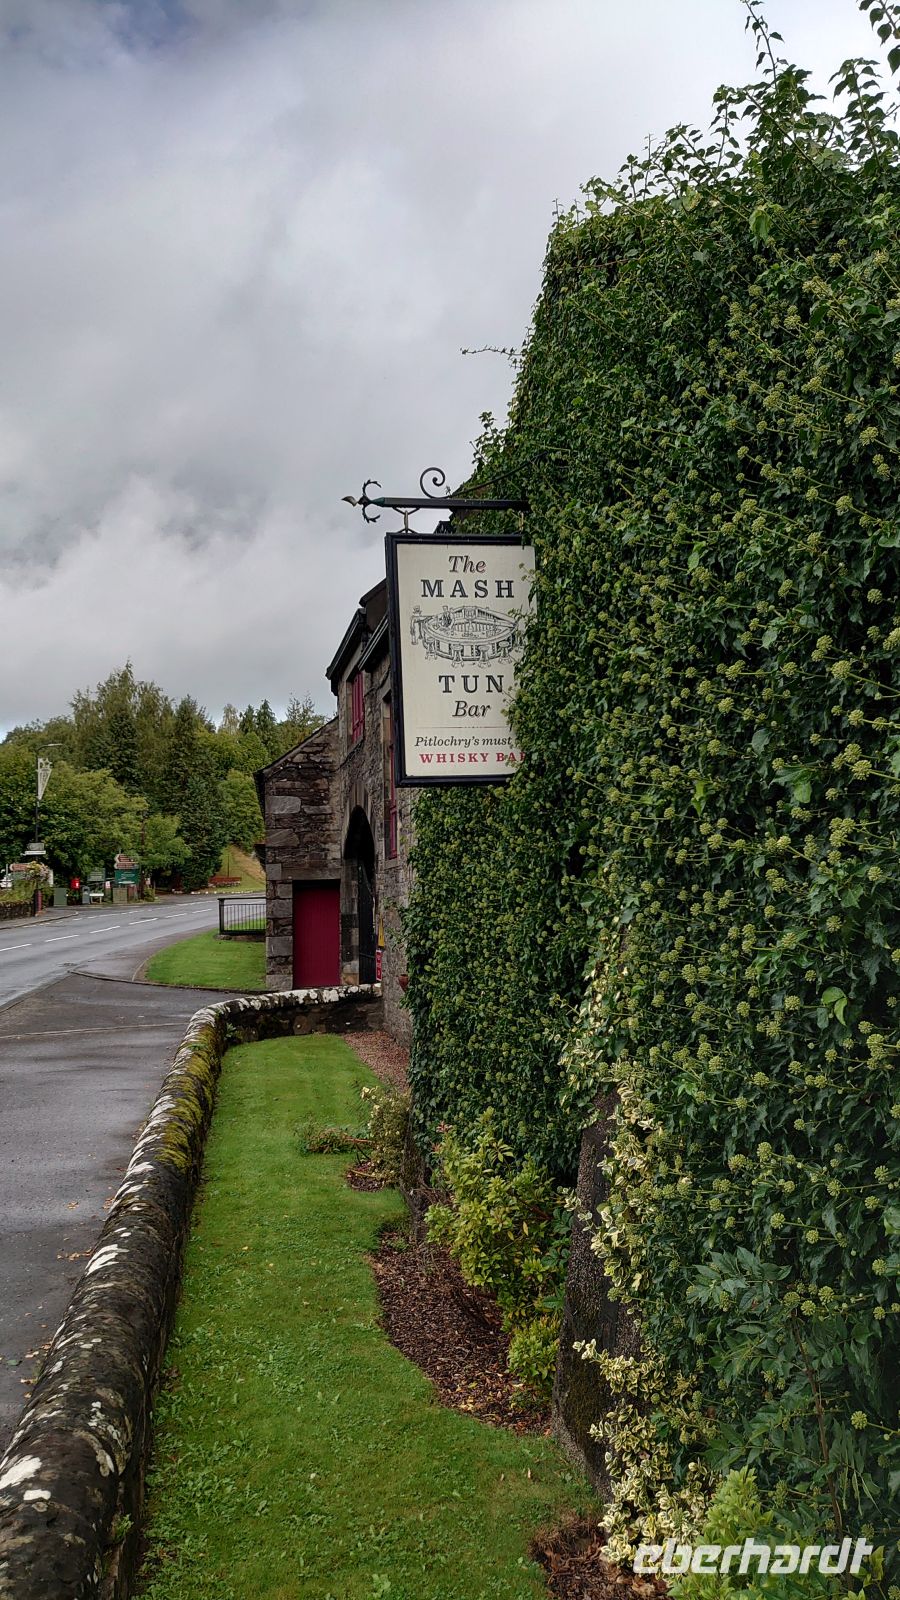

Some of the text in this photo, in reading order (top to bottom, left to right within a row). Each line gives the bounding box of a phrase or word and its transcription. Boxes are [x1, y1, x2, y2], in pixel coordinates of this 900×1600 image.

[448, 555, 487, 573] The
[420, 579, 515, 598] MASH
[438, 675, 505, 693] TUN
[452, 700, 492, 717] Bar
[482, 736, 512, 746] must
[419, 752, 489, 763] WHISKY
